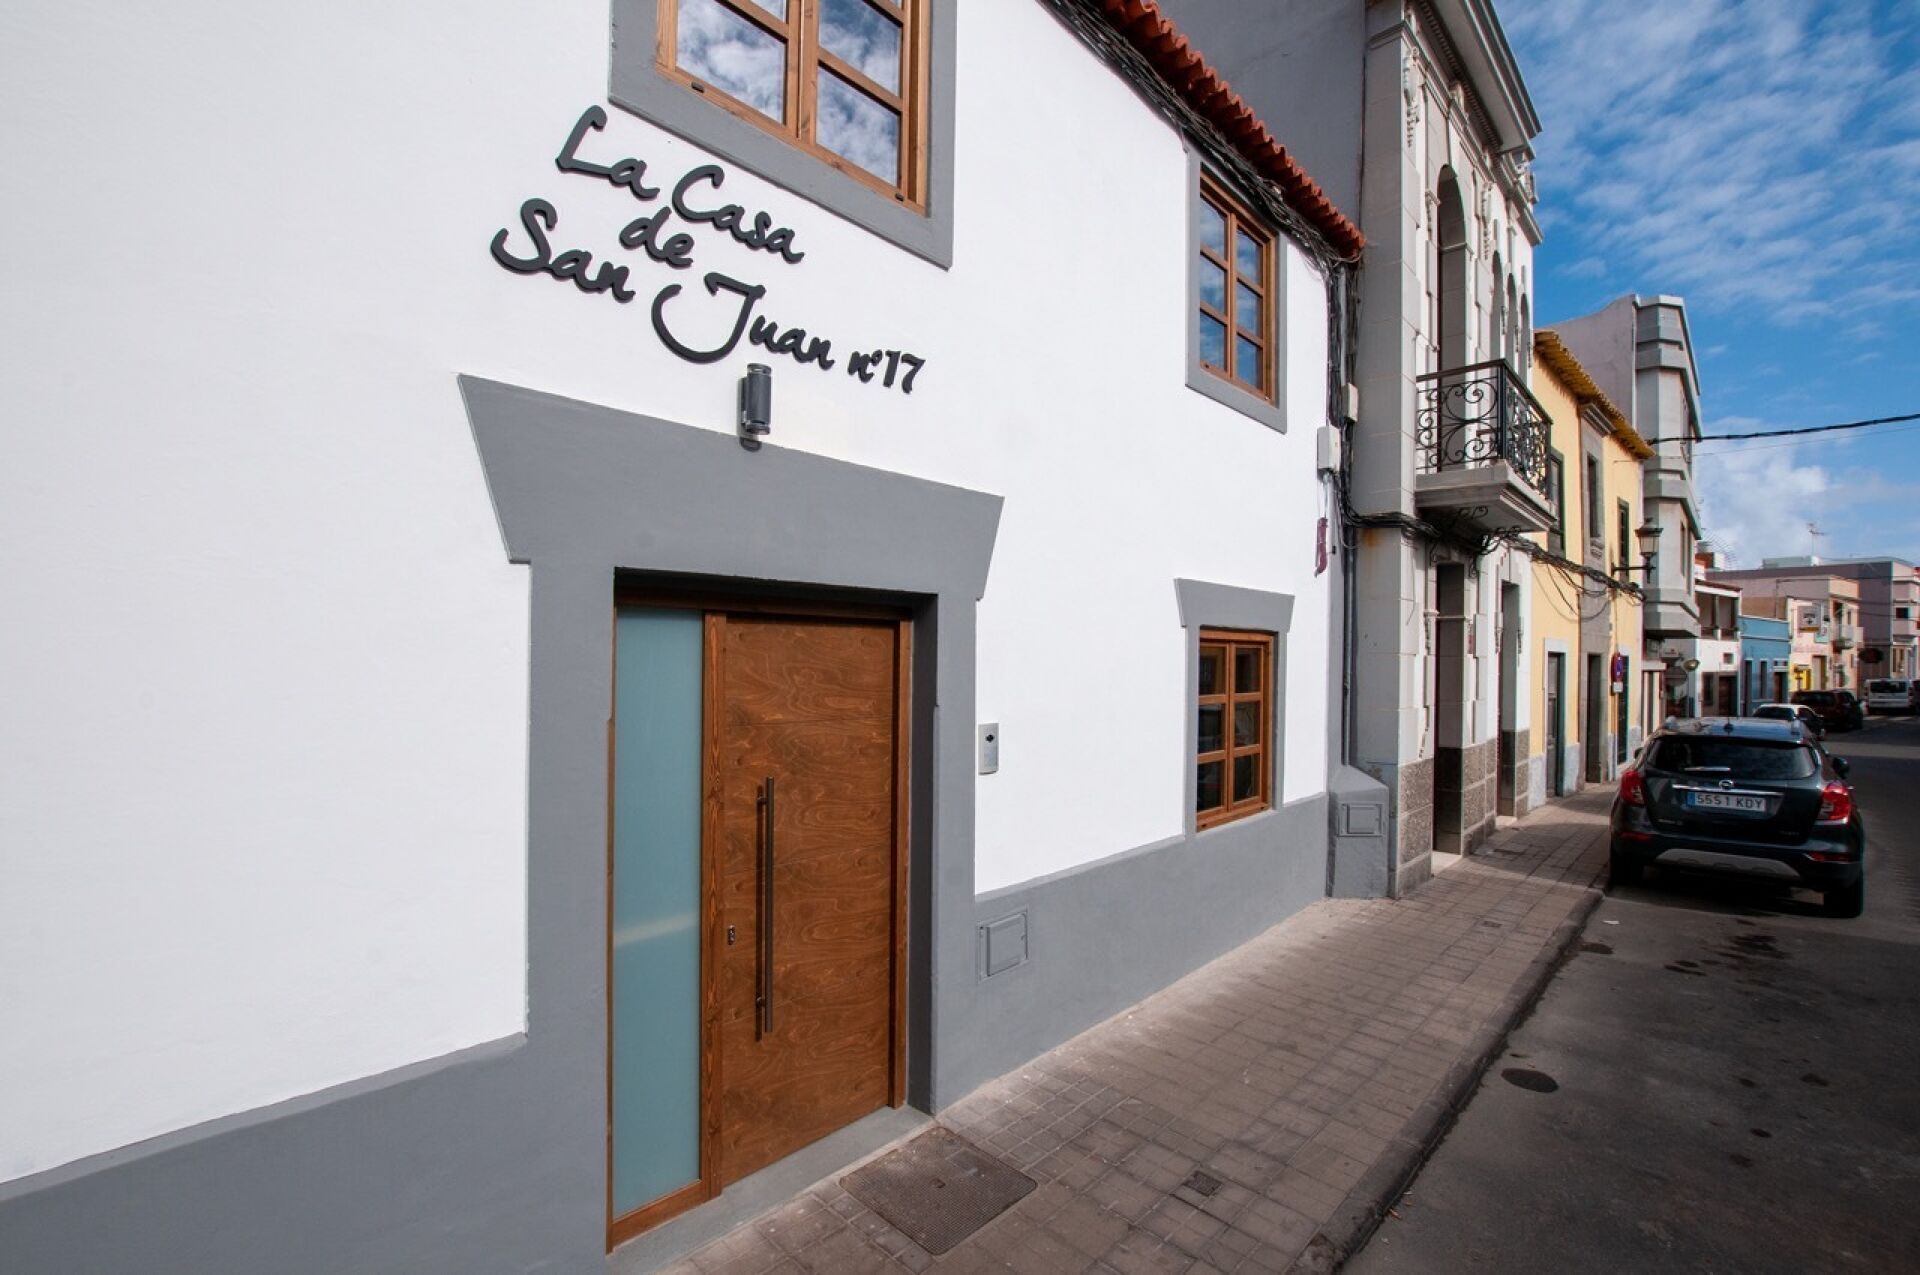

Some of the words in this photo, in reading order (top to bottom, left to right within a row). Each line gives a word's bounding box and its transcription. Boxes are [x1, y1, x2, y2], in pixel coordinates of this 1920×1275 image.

[555, 104, 661, 202] La
[671, 163, 805, 265] Casa
[618, 205, 695, 270] de
[489, 197, 637, 304] San
[651, 271, 836, 371] Juan
